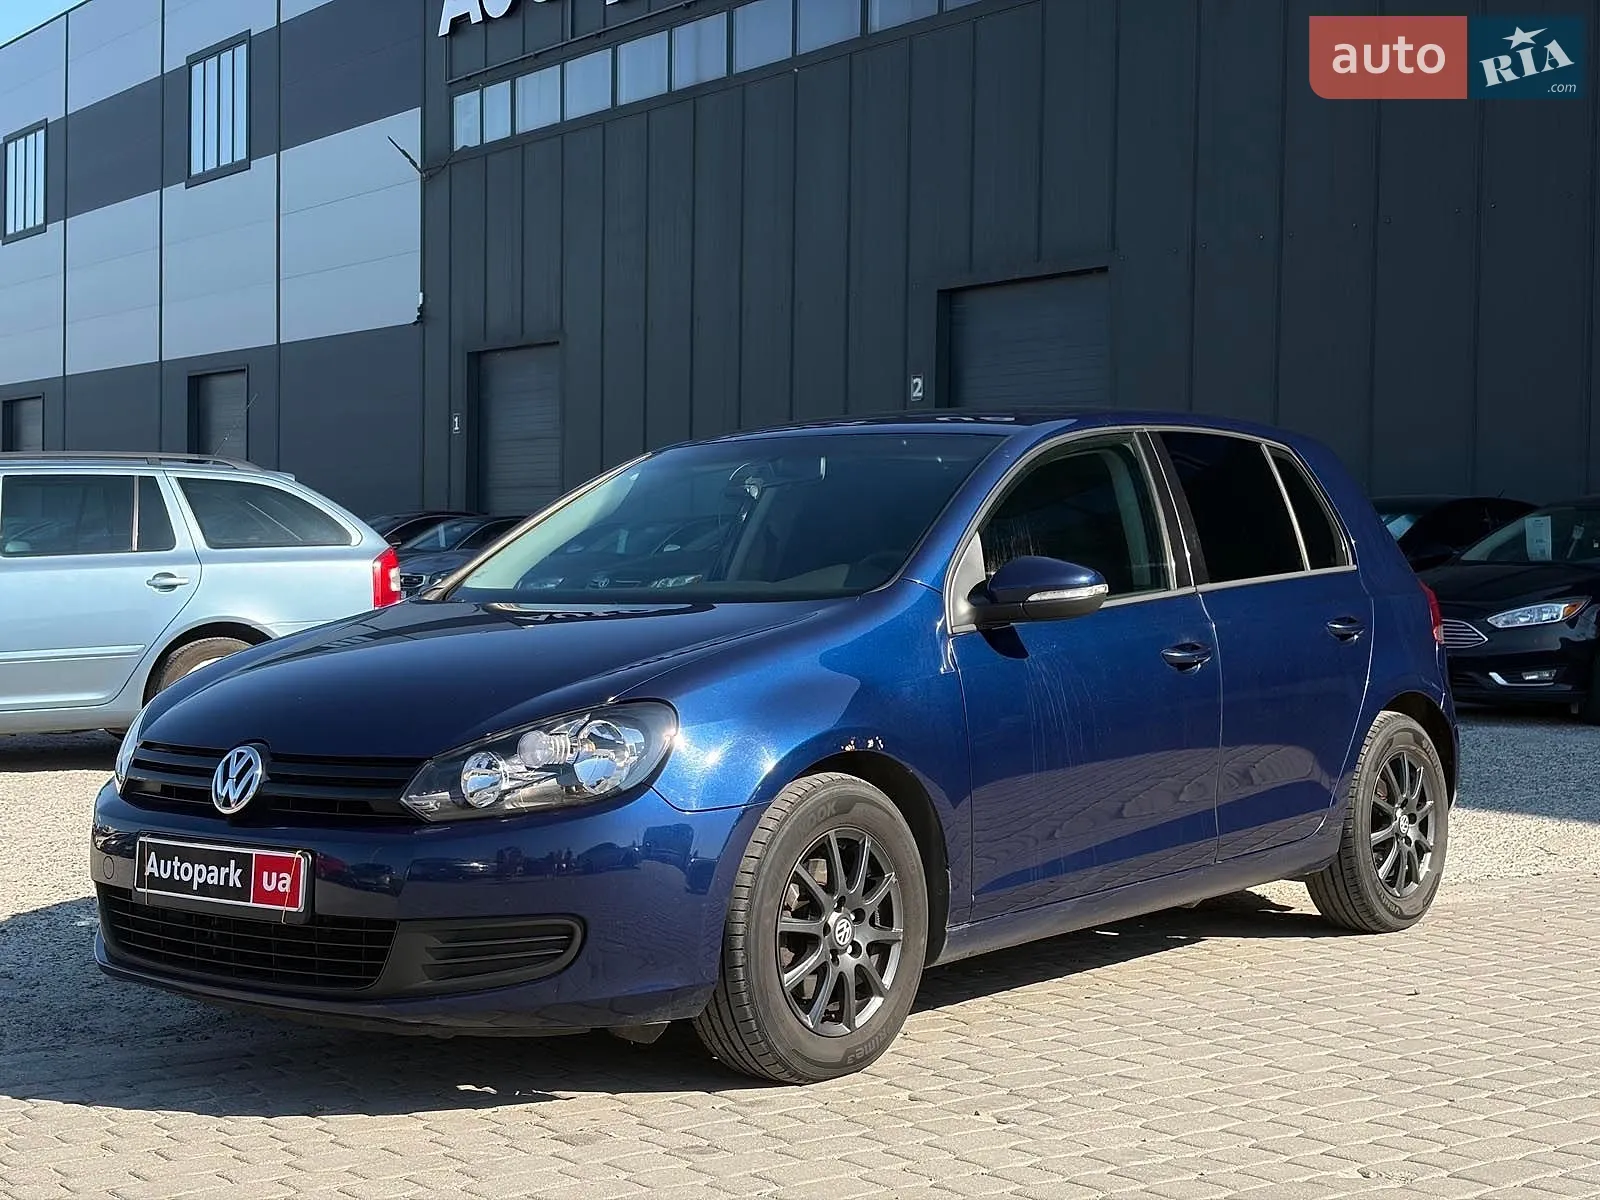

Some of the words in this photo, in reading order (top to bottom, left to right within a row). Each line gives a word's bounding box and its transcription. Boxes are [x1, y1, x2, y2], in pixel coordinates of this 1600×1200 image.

[912, 377, 922, 397] 2
[145, 851, 243, 891] Autopark
[262, 869, 292, 893] ua
